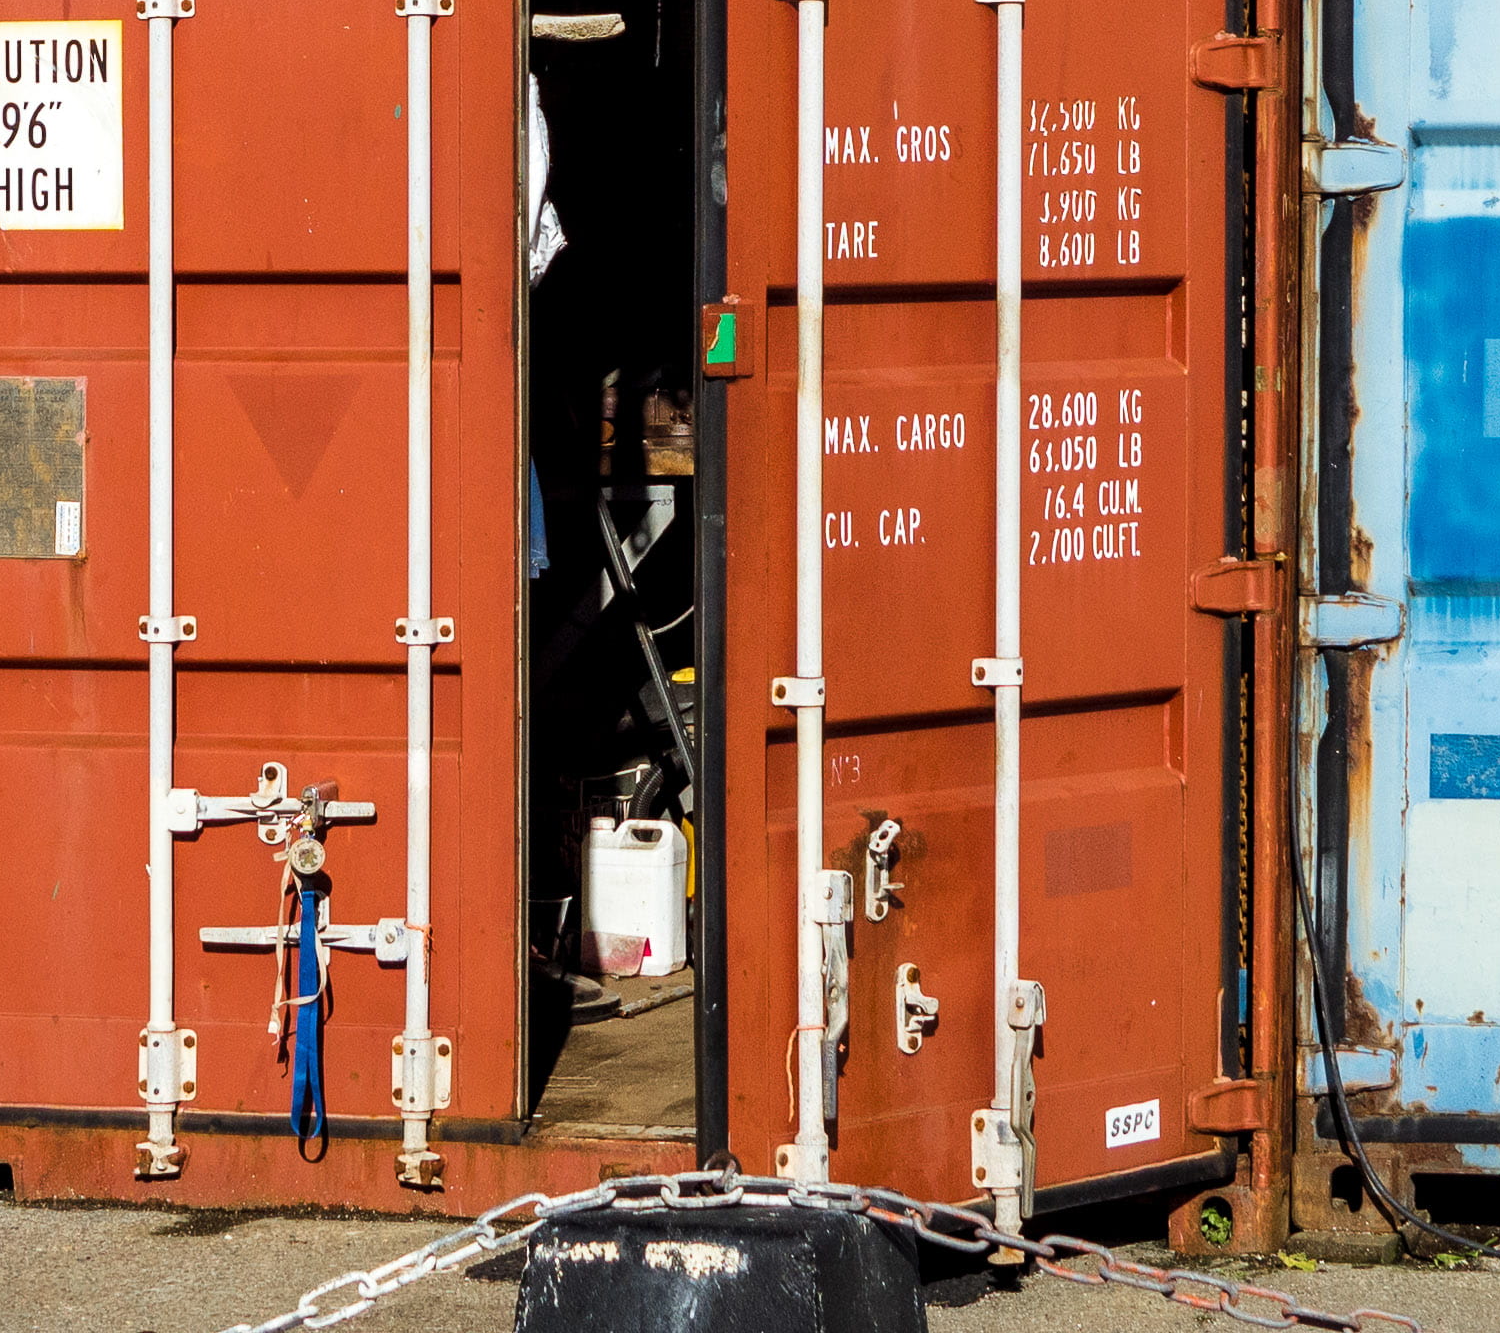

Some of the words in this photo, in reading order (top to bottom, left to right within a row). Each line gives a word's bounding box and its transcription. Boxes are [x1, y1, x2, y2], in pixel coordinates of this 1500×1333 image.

[1118, 96, 1141, 131] KG
[825, 126, 880, 165] MAX.
[1117, 139, 1141, 175] LB
[1118, 185, 1142, 221] KG
[825, 220, 878, 260] TARE
[1039, 232, 1096, 268] 8,600
[1117, 229, 1141, 265] LB
[1028, 391, 1098, 430] 28,600
[1119, 388, 1142, 425] KG
[825, 416, 880, 455] MAX.
[895, 413, 967, 452] CARGO
[1118, 432, 1142, 469] LB
[1098, 478, 1143, 517] CU.M.
[825, 511, 860, 550] CU.
[878, 508, 926, 545] CAP.
[1092, 521, 1141, 561] CU.FT.
[1111, 1109, 1154, 1138] SSPC
